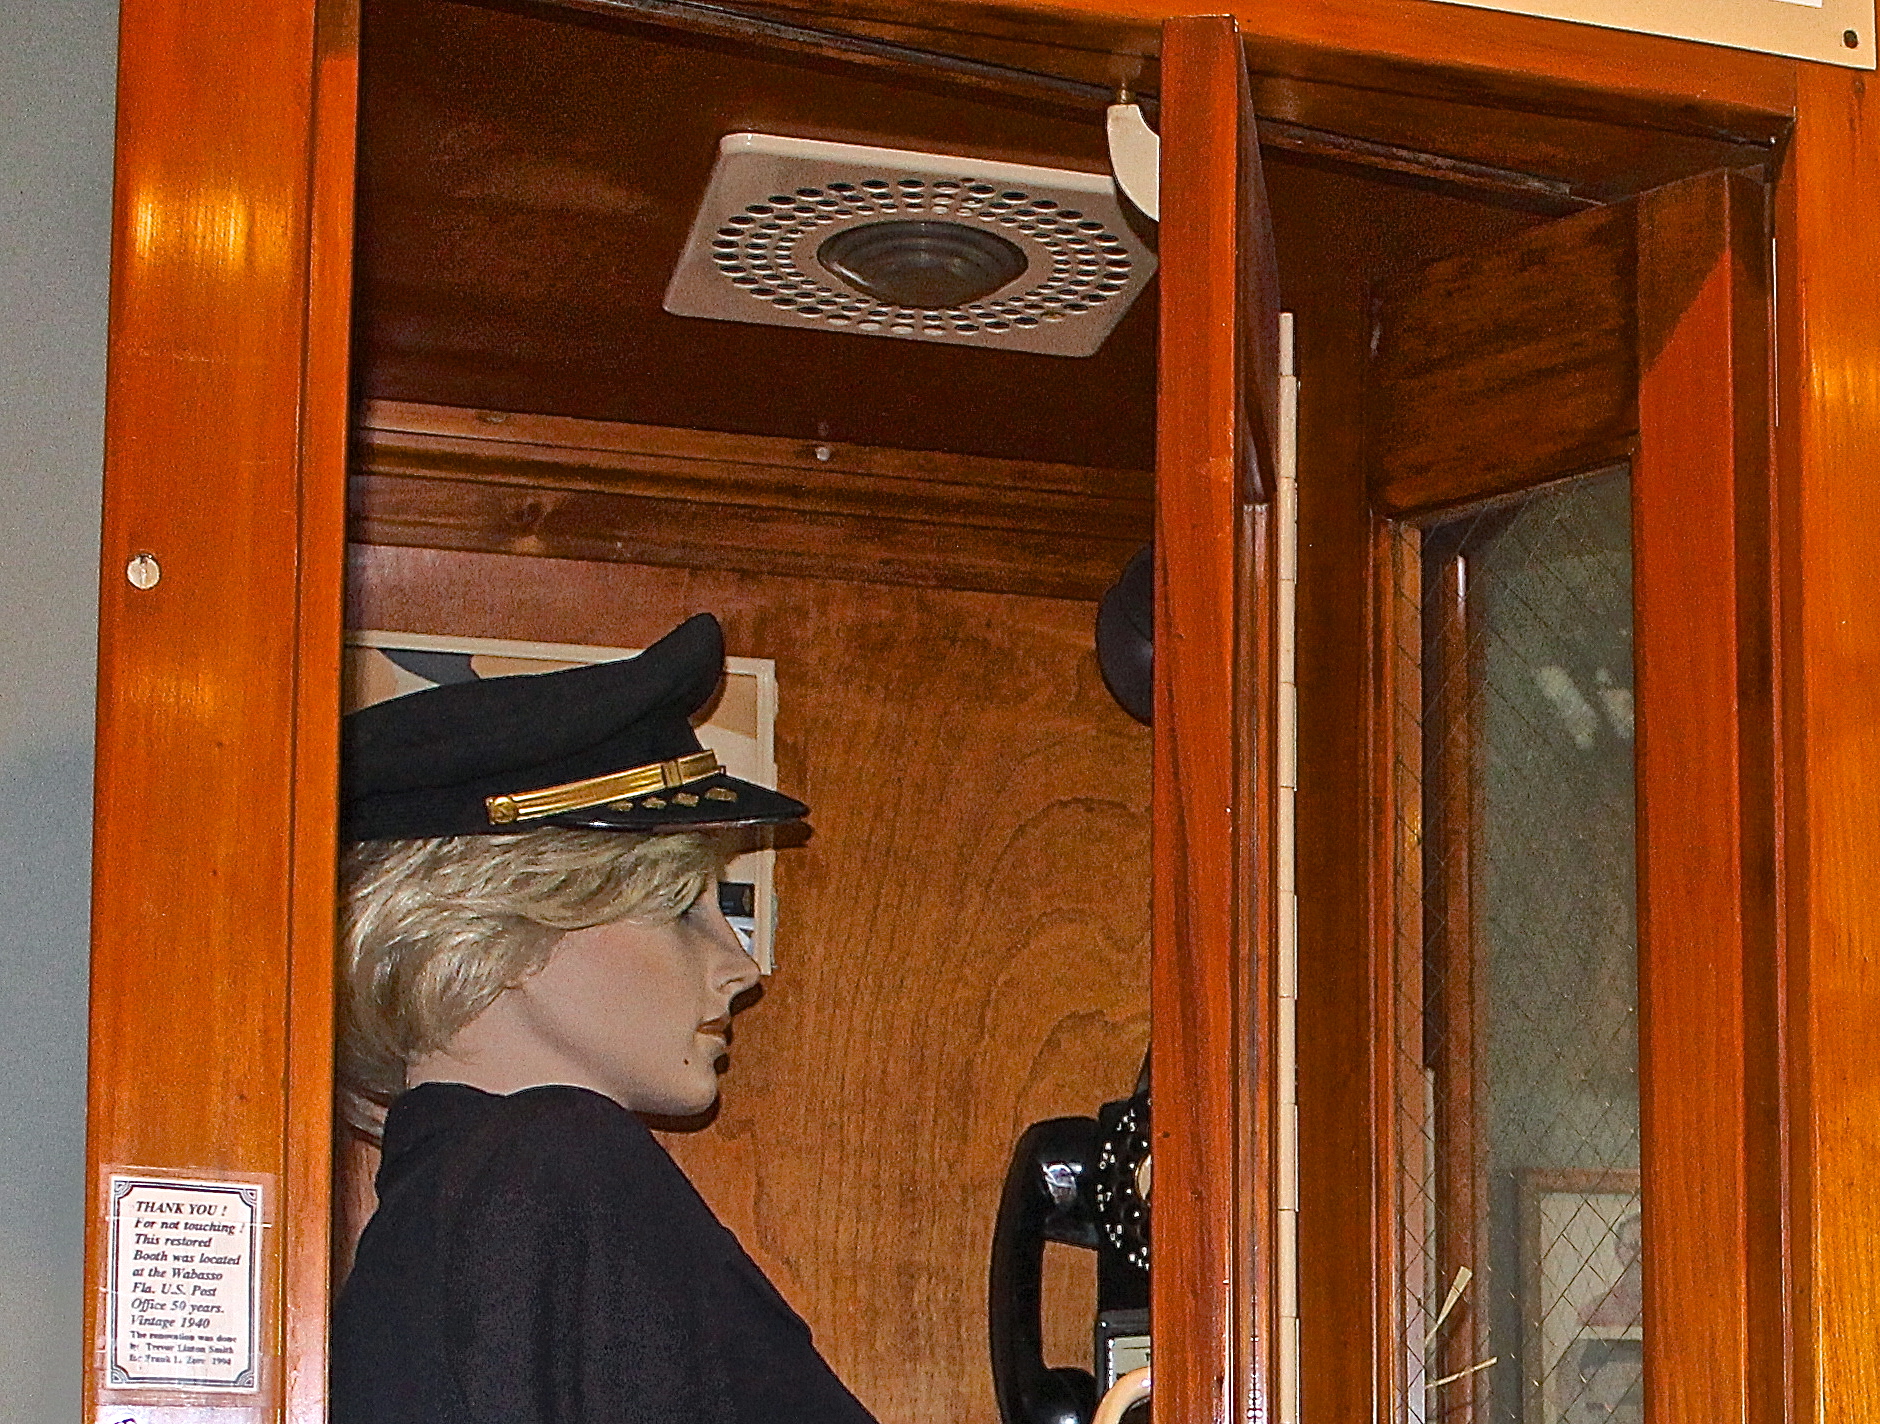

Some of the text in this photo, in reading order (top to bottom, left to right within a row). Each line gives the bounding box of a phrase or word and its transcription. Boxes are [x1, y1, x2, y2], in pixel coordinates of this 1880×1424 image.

[136, 1201, 185, 1214] THANK
[189, 1203, 218, 1216] YOU
[134, 1217, 157, 1229] For
[160, 1221, 180, 1230] not
[184, 1221, 236, 1235] touching
[135, 1233, 213, 1248] This restored
[133, 1249, 242, 1265] Booth was located
[132, 1266, 223, 1281] at the Wabasso
[132, 1282, 217, 1297] Fla. U.S. Post
[131, 1298, 225, 1315] Office 50 years.
[131, 1314, 211, 1329] Vintage 1940
